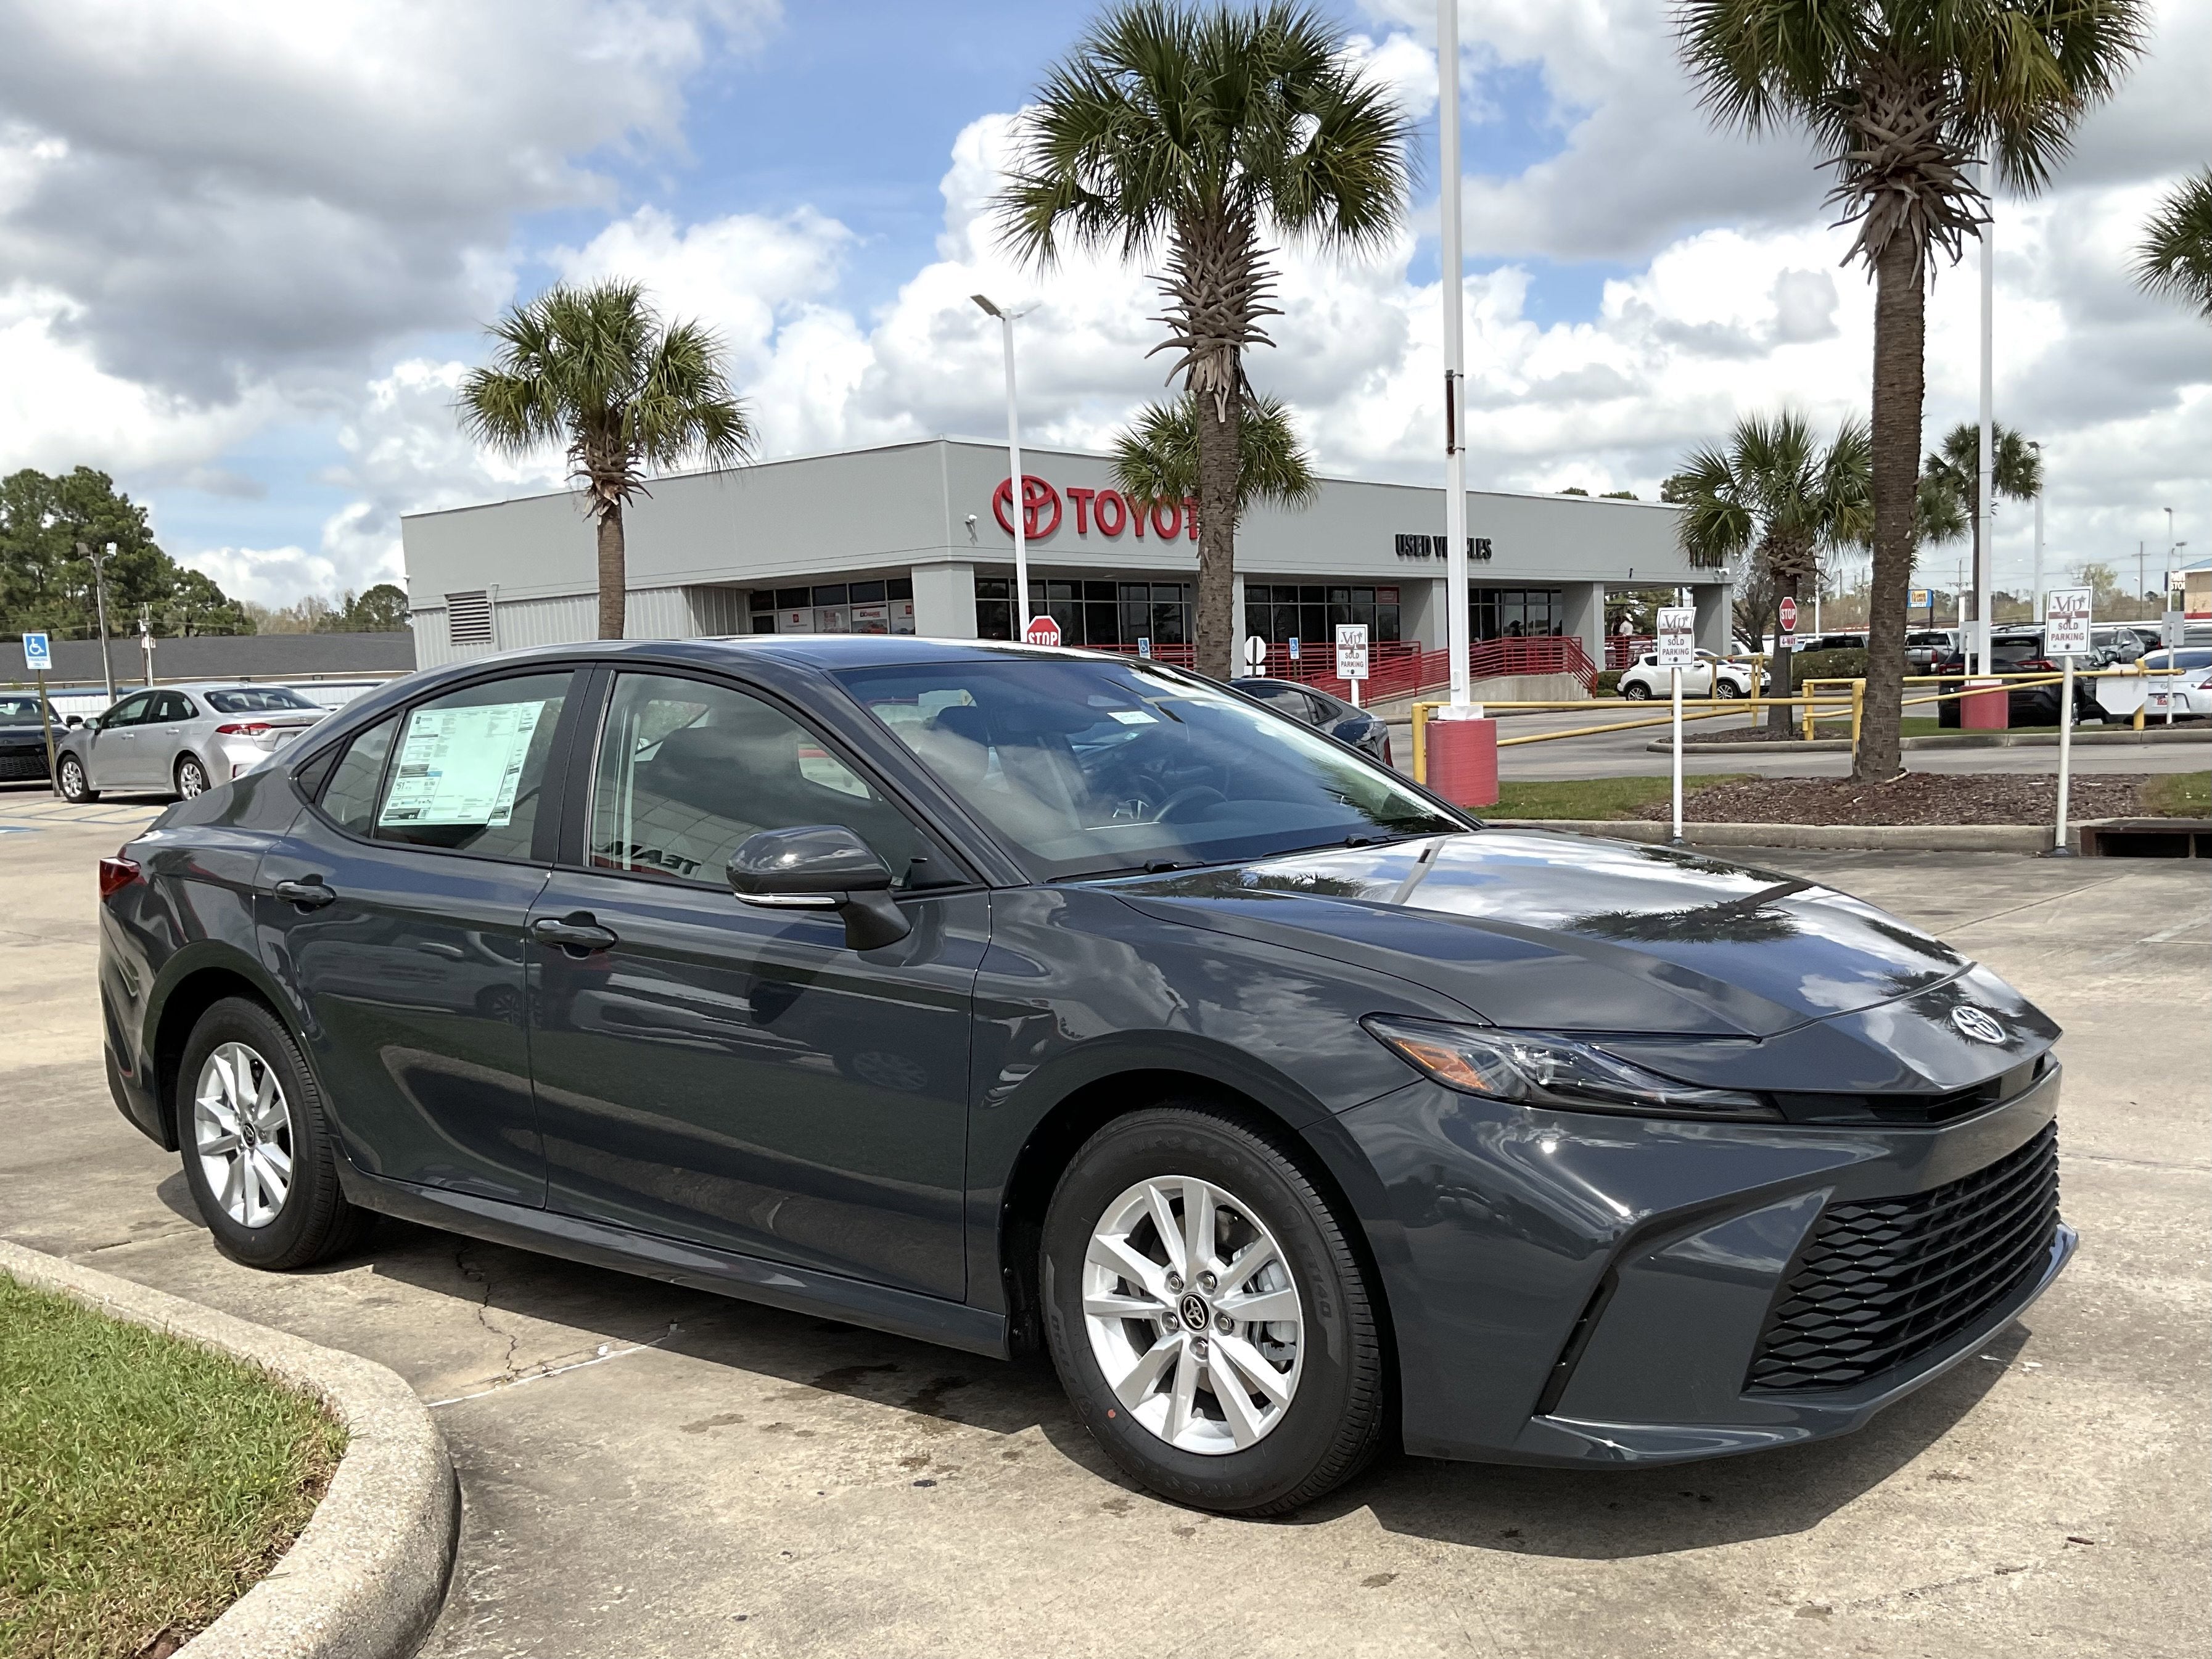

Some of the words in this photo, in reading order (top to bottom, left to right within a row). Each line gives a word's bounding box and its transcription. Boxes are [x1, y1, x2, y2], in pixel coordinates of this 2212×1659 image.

[1067, 488, 1199, 539] TOYOT
[1395, 534, 1432, 556] USED
[1433, 536, 1492, 559] VLES
[1781, 608, 1796, 620] STOP
[2058, 622, 2079, 630] SOLD
[1028, 631, 1058, 646] STOP
[1782, 637, 1796, 646] 4-WAY
[2050, 632, 2084, 641] PARKING
